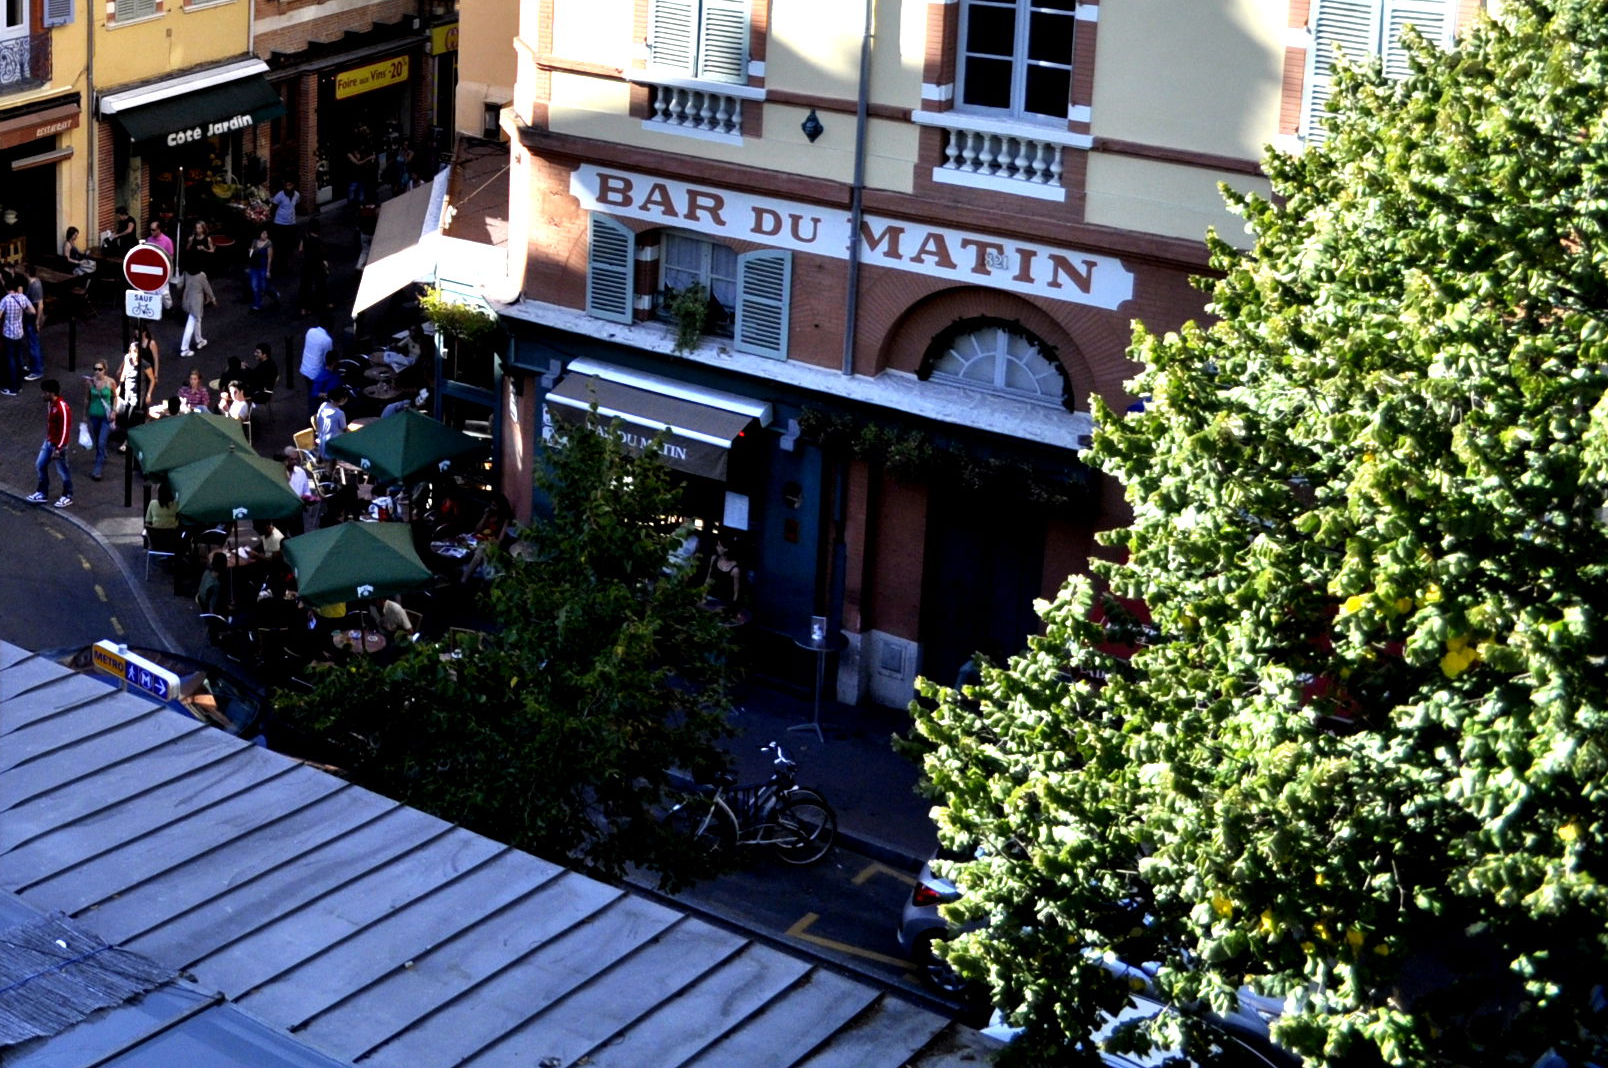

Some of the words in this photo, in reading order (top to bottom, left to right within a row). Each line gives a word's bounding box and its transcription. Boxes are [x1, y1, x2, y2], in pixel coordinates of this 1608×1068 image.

[338, 77, 358, 90] Foire
[370, 70, 386, 81] Vins
[36, 119, 73, 137] RESTAURANT
[206, 114, 254, 137] Jardin
[595, 172, 727, 227] BAR
[750, 205, 822, 243] DU
[846, 217, 1098, 295] MATIN
[134, 293, 153, 303] SAUF
[94, 650, 124, 672] METRO
